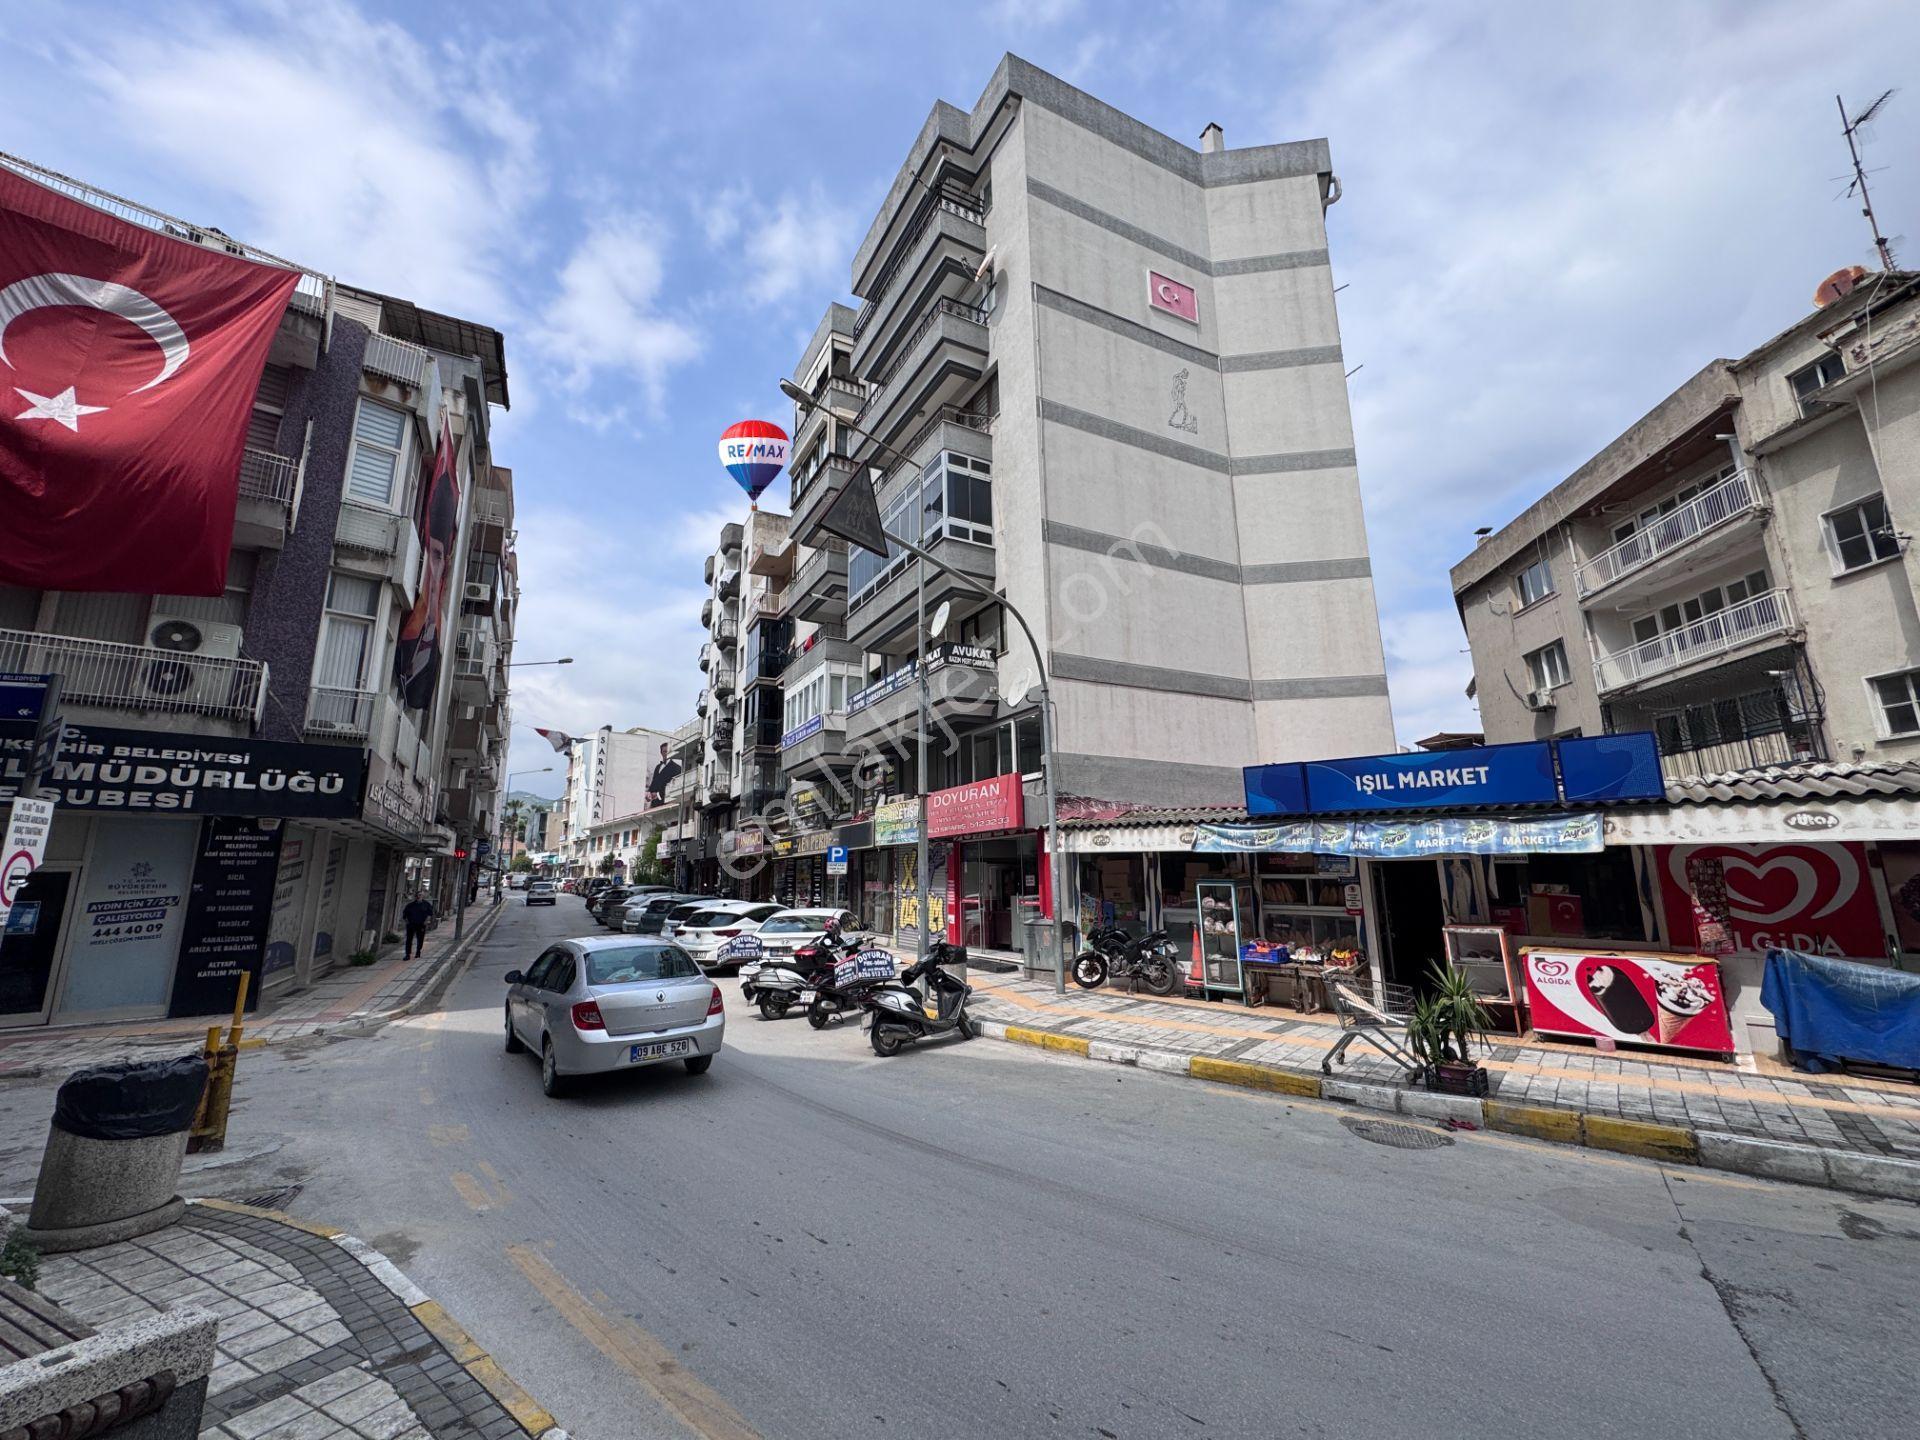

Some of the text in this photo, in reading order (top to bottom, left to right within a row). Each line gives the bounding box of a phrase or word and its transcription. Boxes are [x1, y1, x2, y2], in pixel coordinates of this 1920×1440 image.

[728, 444, 784, 458] RE/MAX
[952, 645, 992, 660] AVUKAT
[113, 745, 250, 765] BELEDİYESİ
[52, 758, 344, 795] MÜDÜRLÜĞÜ
[593, 736, 606, 819] SARANLAR
[1355, 766, 1489, 795] IŞIL MARKET
[933, 783, 1000, 808] DOYURAN
[1383, 831, 1409, 845] Ayran
[1466, 829, 1493, 844] Ayran
[1562, 824, 1594, 842] Ayran
[1284, 837, 1315, 847] MARKET
[1415, 836, 1456, 848] MARKET
[1502, 835, 1552, 846] MARKET
[832, 847, 844, 862] P
[90, 902, 122, 911] AYDIN
[124, 899, 144, 910] İÇİN
[97, 910, 164, 924] ÇALIŞIYORUZ
[92, 923, 164, 937] 444 40 09
[731, 936, 761, 946] DOYURAN
[857, 950, 892, 963] DOYURAN
[637, 1047, 648, 1057] 09
